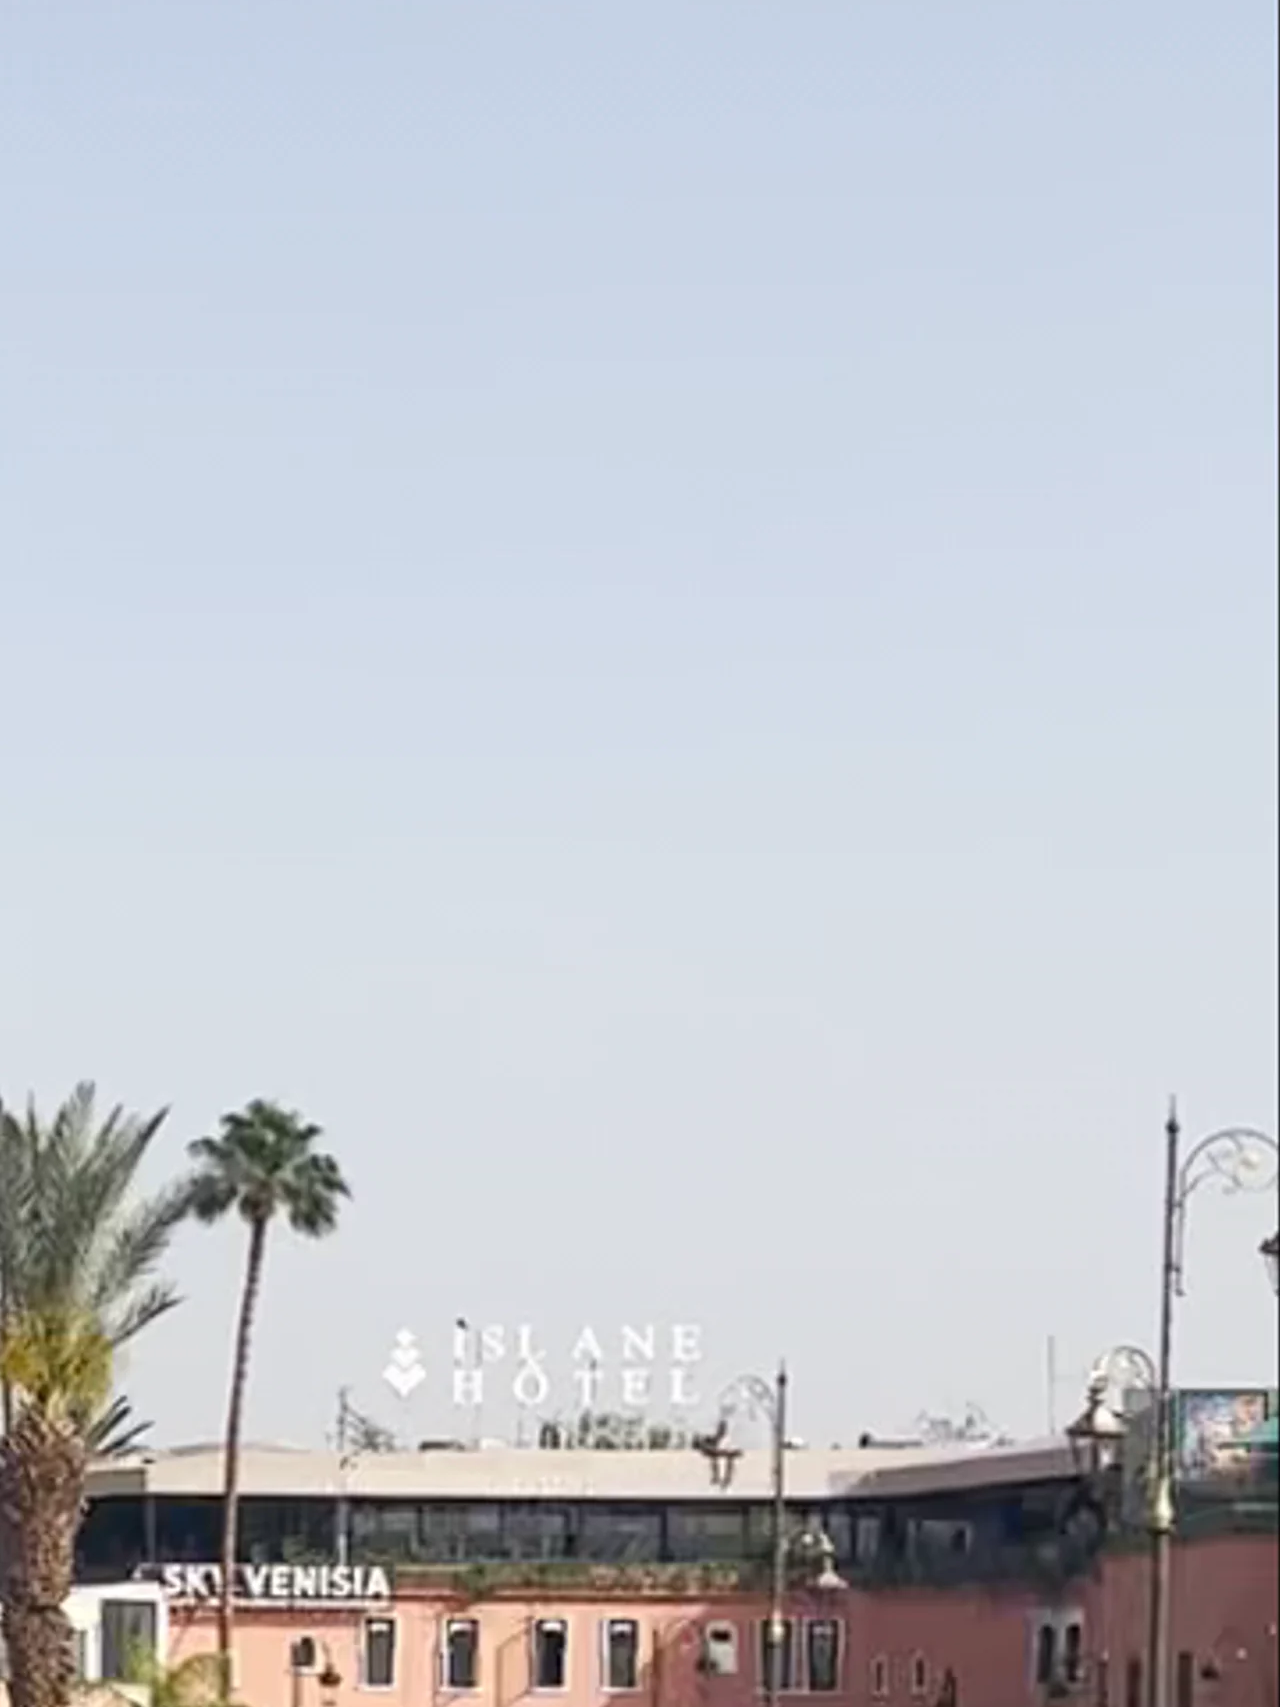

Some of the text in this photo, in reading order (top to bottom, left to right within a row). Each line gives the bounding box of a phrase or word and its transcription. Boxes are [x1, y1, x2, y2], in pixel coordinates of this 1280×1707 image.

[449, 1324, 702, 1362] ISLANE
[449, 1368, 700, 1405] HOTEL
[244, 1564, 391, 1596] VENISIA
